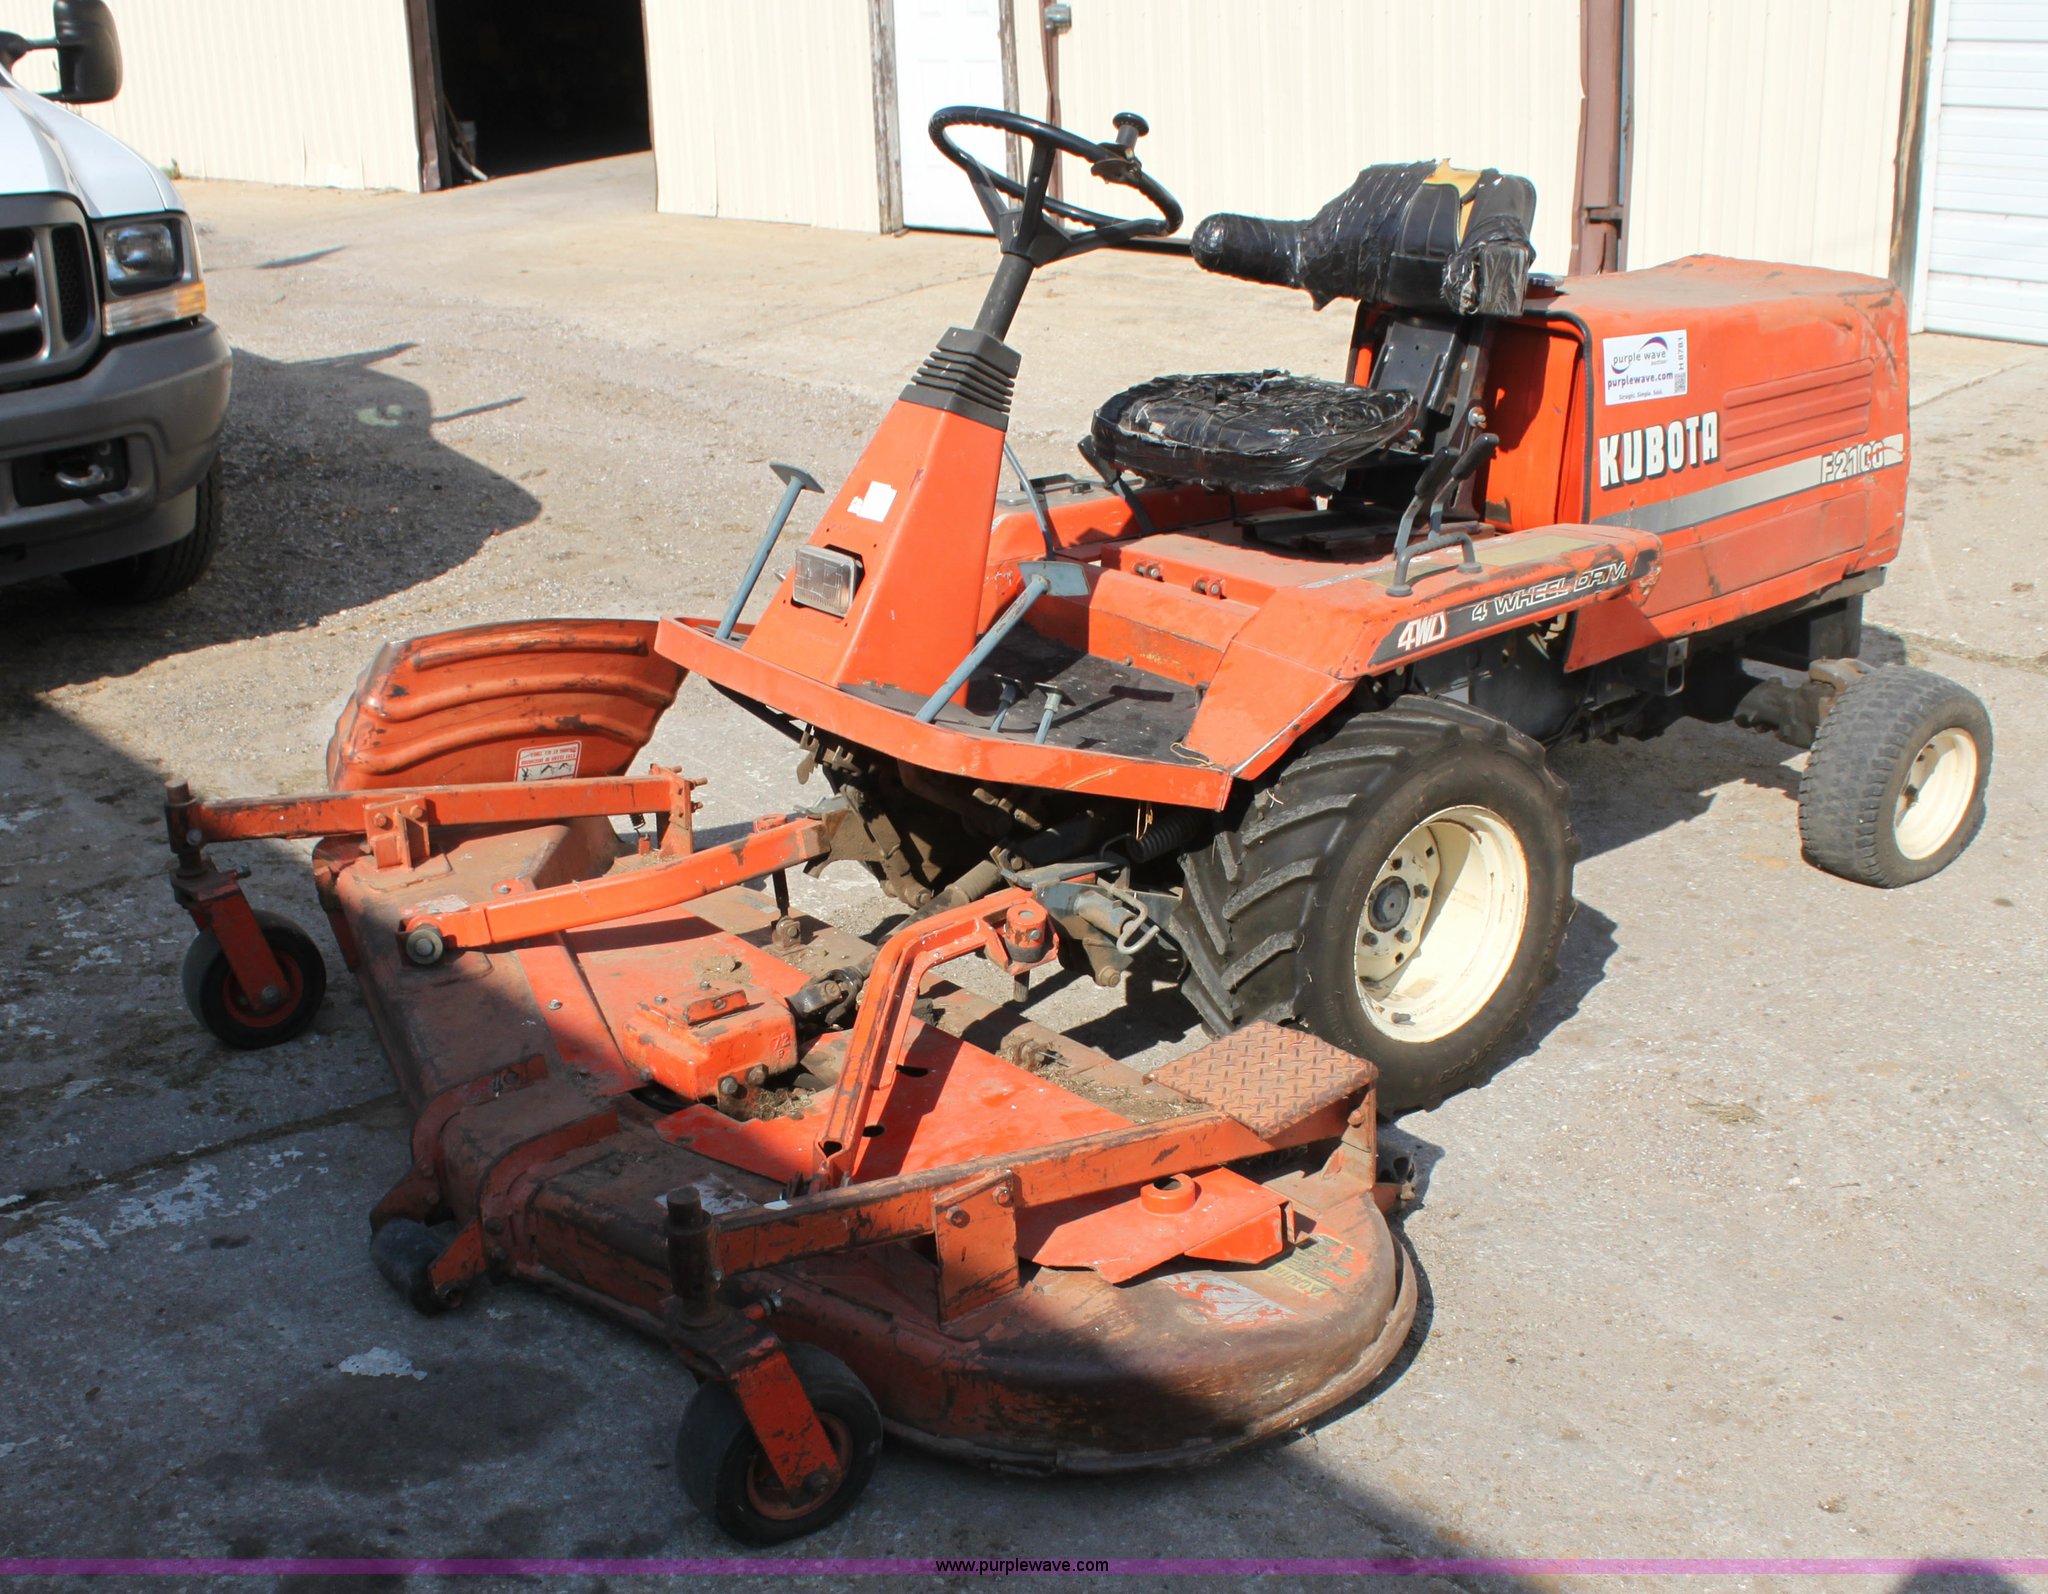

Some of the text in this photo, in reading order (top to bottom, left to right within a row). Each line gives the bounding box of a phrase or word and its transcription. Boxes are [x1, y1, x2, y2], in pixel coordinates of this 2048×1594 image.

[1613, 352, 1641, 366] purple
[1644, 350, 1667, 360] wave
[1608, 372, 1673, 390] purplewave.com
[1599, 411, 1719, 489] KUBOTA
[1471, 601, 1488, 623] 4
[1494, 578, 1568, 615] WHEEL
[1397, 611, 1446, 651] 4WD
